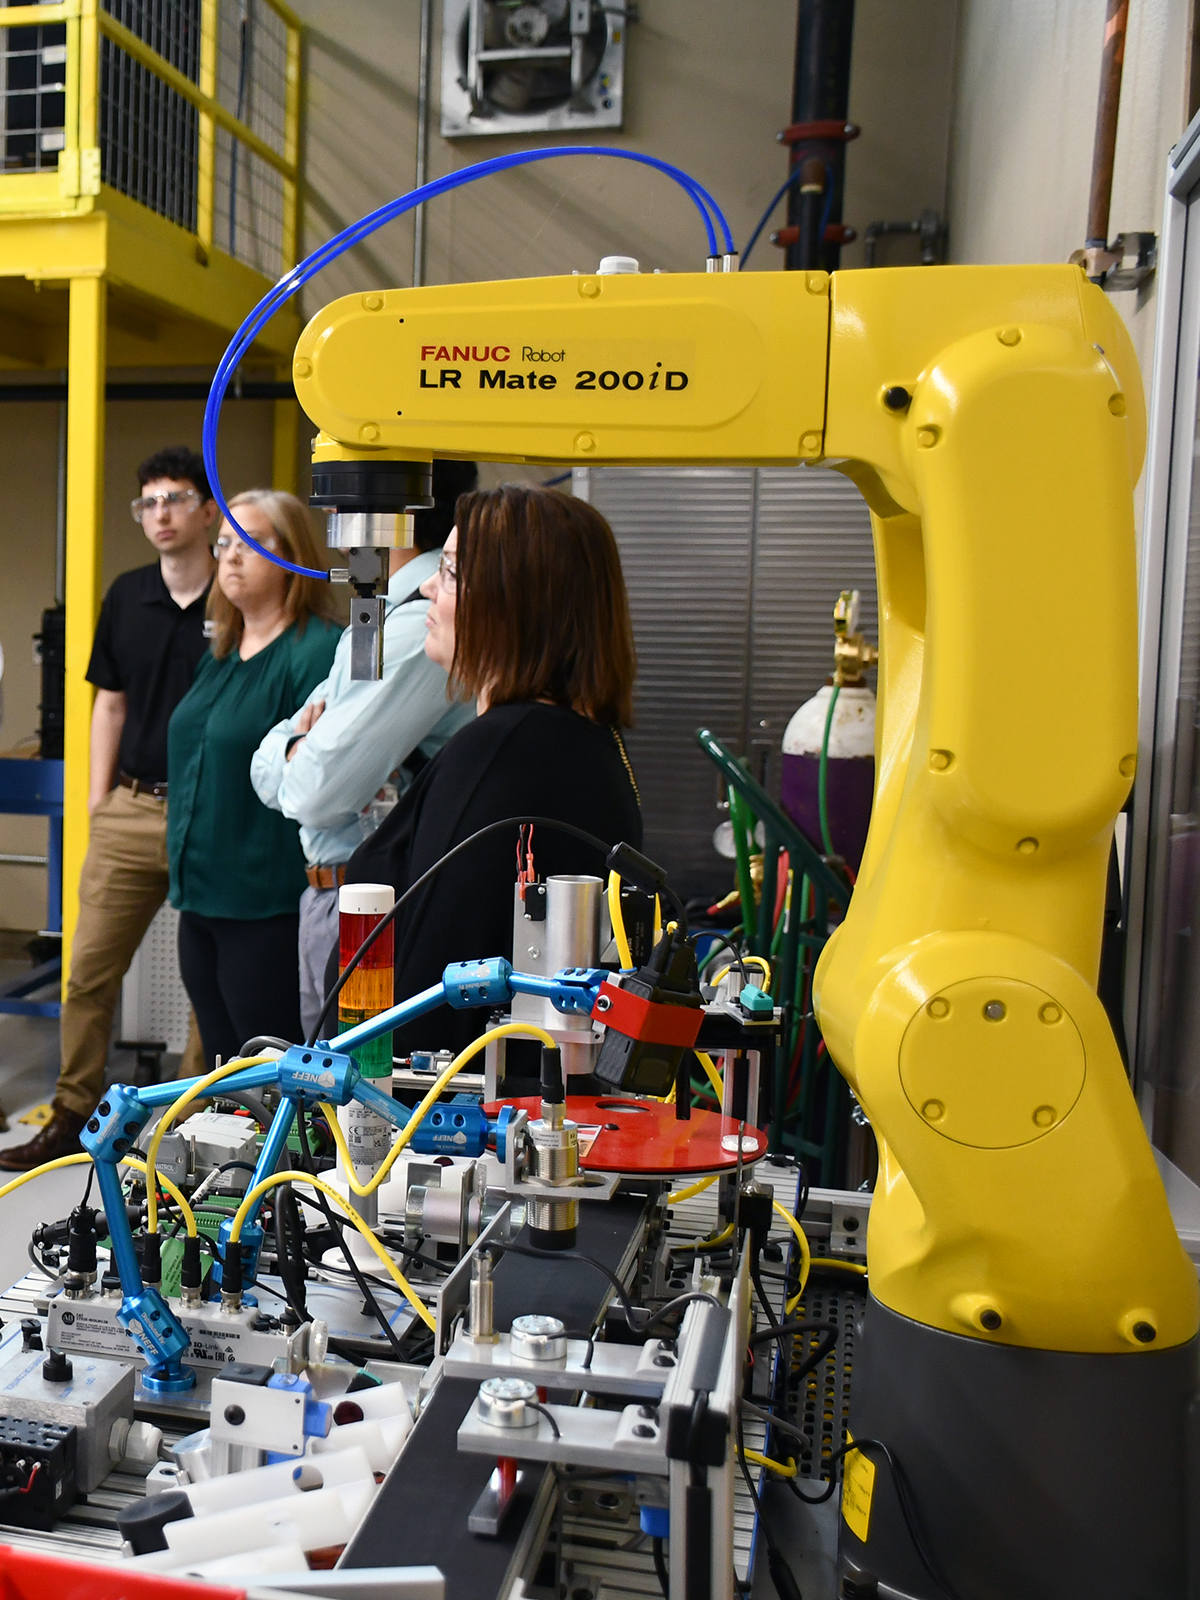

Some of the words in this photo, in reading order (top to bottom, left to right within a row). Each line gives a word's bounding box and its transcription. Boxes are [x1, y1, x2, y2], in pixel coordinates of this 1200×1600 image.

[420, 345, 511, 362] FANUC
[521, 346, 566, 363] Robot
[419, 369, 462, 389] LR
[479, 369, 557, 390] Mate
[574, 361, 689, 391] 200iD
[292, 1070, 320, 1083] NEFF
[432, 1133, 455, 1142] NEFF
[139, 1332, 159, 1355] NEFF
[194, 1341, 219, 1350] IO-Link
